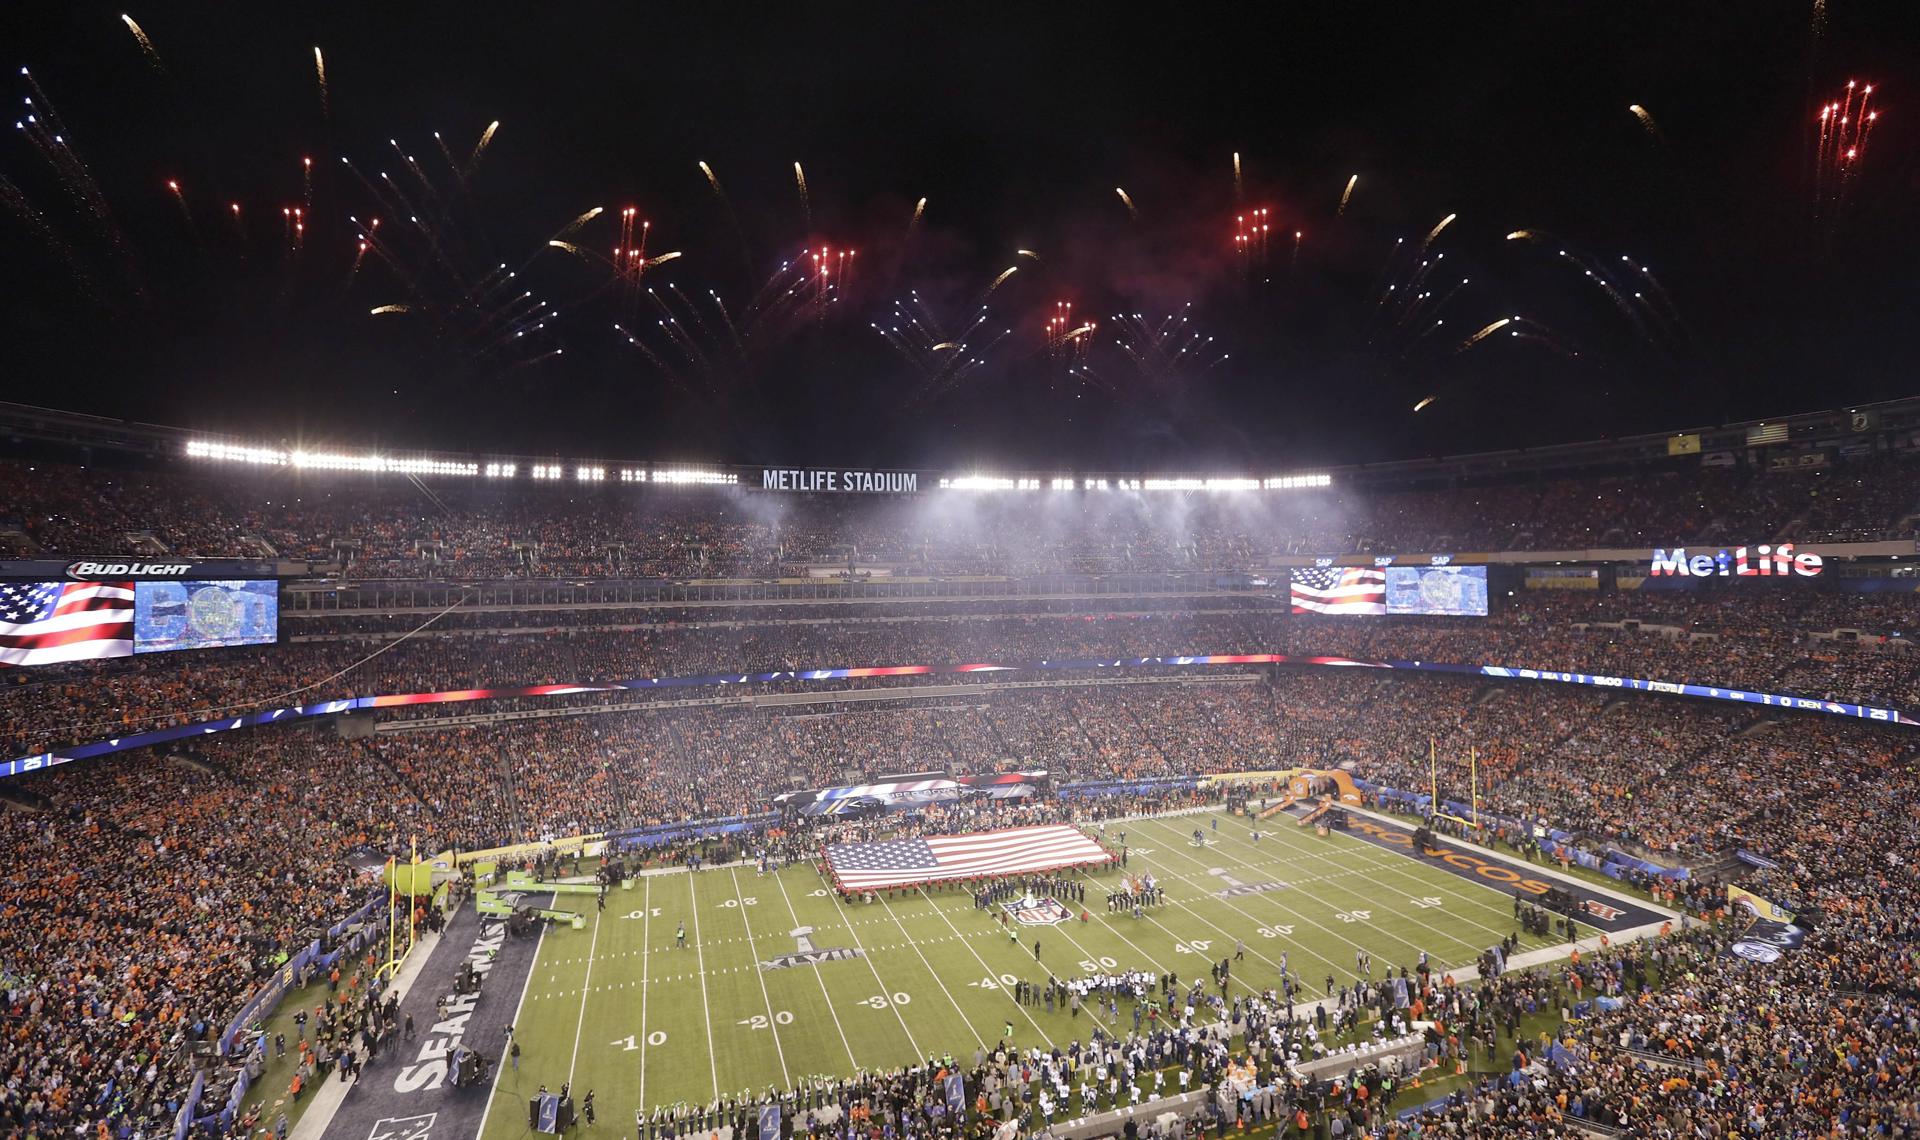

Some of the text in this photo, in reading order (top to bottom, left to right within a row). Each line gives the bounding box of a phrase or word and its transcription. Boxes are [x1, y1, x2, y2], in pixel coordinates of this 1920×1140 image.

[763, 470, 917, 492] METLIFE STADIUM
[1315, 558, 1333, 568] SAP
[1375, 557, 1392, 567] SAP
[1432, 556, 1450, 566] SAP
[1651, 543, 1823, 577] MetLife
[76, 562, 192, 575] BUD LIGHT
[1798, 700, 1822, 710] DEN
[1869, 708, 1888, 720] 25
[24, 756, 42, 771] 25
[527, 843, 582, 857] SEAHWKS
[1335, 910, 1371, 923] 20
[1257, 924, 1293, 938] 30
[1175, 940, 1209, 954] 40
[760, 948, 865, 971] XLVIII
[1078, 956, 1118, 972] 50
[980, 974, 1018, 990] 40
[394, 922, 505, 1093] SEAHWKS
[869, 992, 911, 1009] 30
[750, 1011, 794, 1030] 20
[622, 1031, 668, 1051] 10
